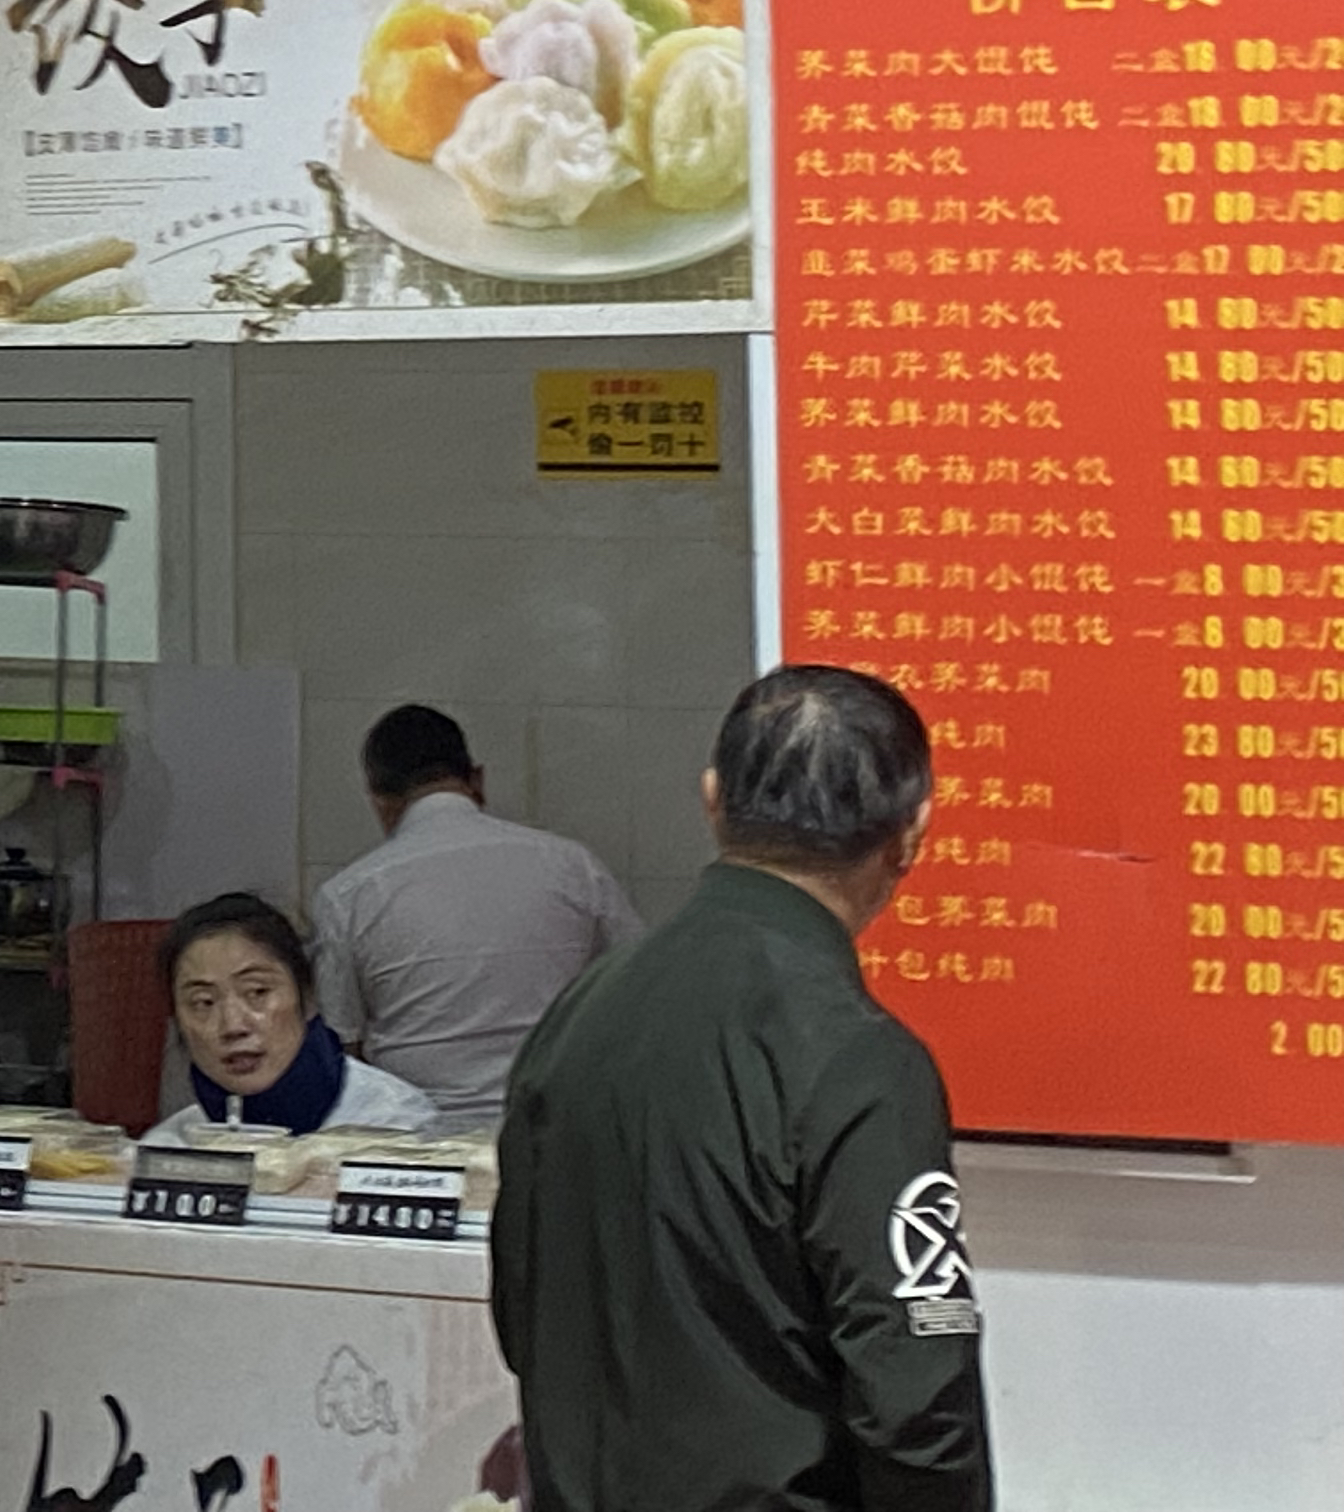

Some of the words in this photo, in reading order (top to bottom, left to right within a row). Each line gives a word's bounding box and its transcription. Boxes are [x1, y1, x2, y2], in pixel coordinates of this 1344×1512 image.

[795, 146, 968, 177] 纯肉水饺
[802, 351, 1062, 381] 牛肉芹菜水饺
[805, 506, 1116, 539] 大白菜鲜肉水饺
[805, 560, 1115, 593] 虾仁鲜肉小馄饨
[915, 836, 1011, 866] 纯肉
